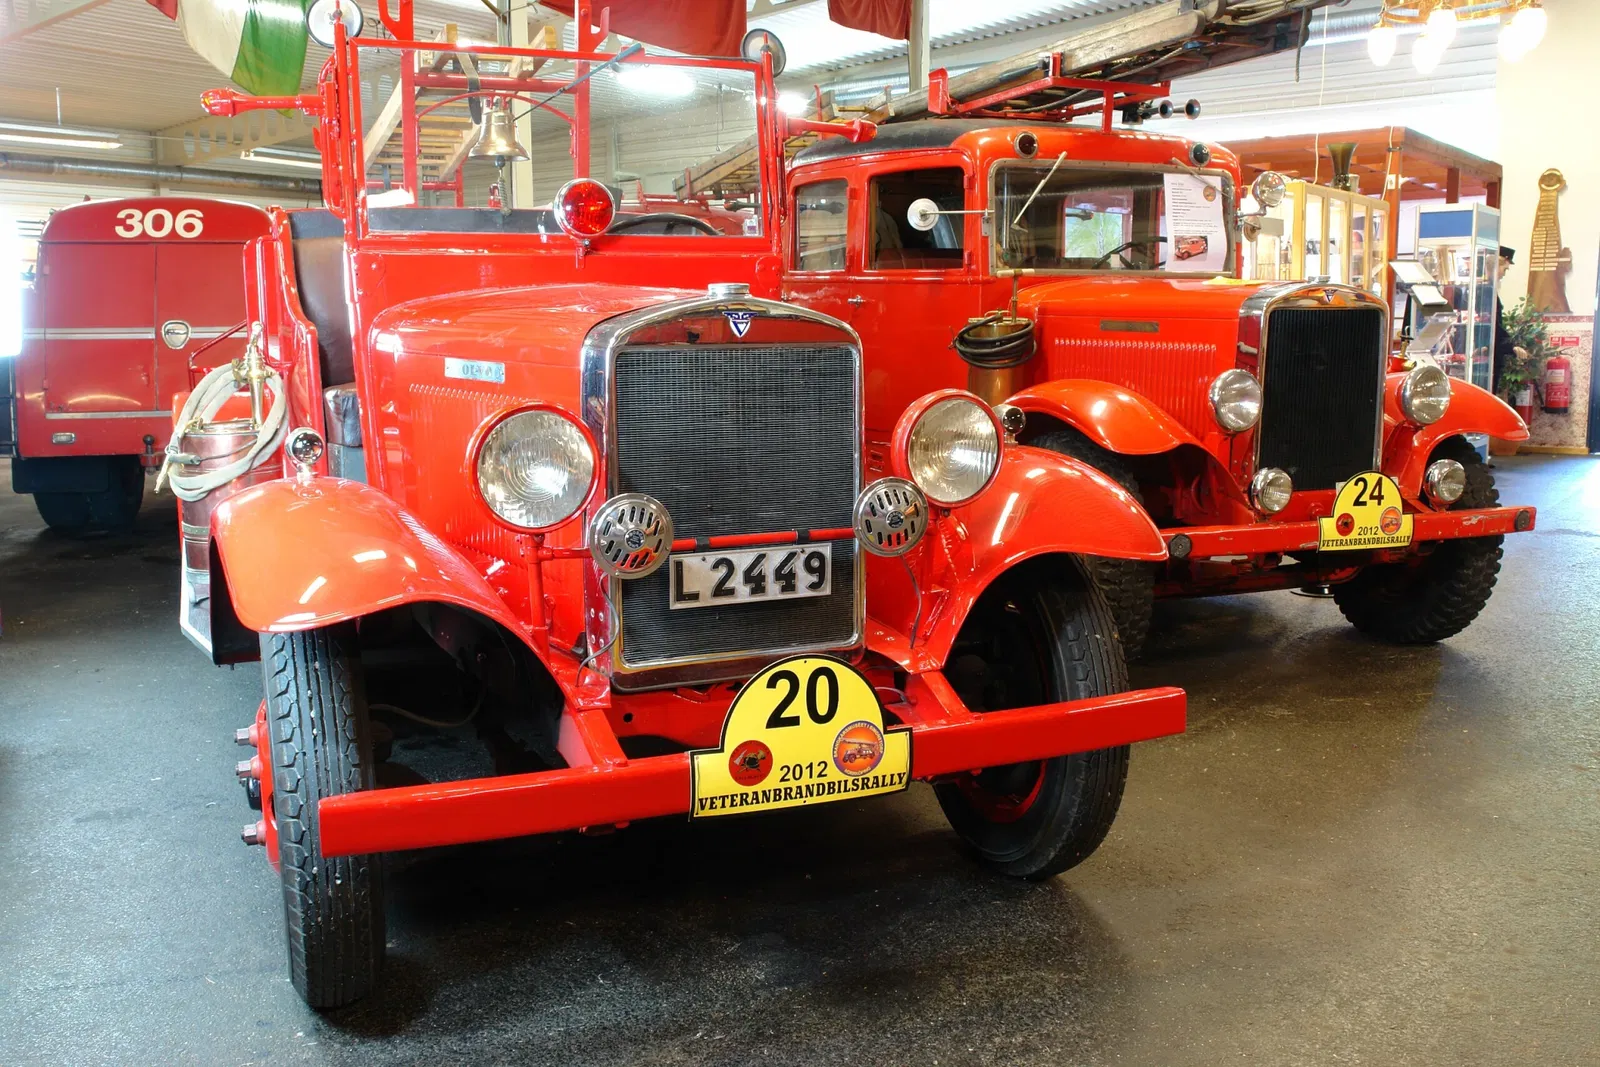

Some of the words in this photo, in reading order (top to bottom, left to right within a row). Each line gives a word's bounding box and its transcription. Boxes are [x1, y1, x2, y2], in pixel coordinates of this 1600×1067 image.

[114, 208, 204, 239] 306
[1353, 476, 1384, 506] 24
[1322, 535, 1411, 547] VETERANBRANDBILSRALLY
[1357, 526, 1379, 536] 2012
[674, 559, 700, 603] L
[711, 550, 827, 598] 2449
[765, 666, 839, 729] 20
[779, 760, 828, 783] 2012
[698, 772, 907, 811] VETERANBRANDBILSRALLY
